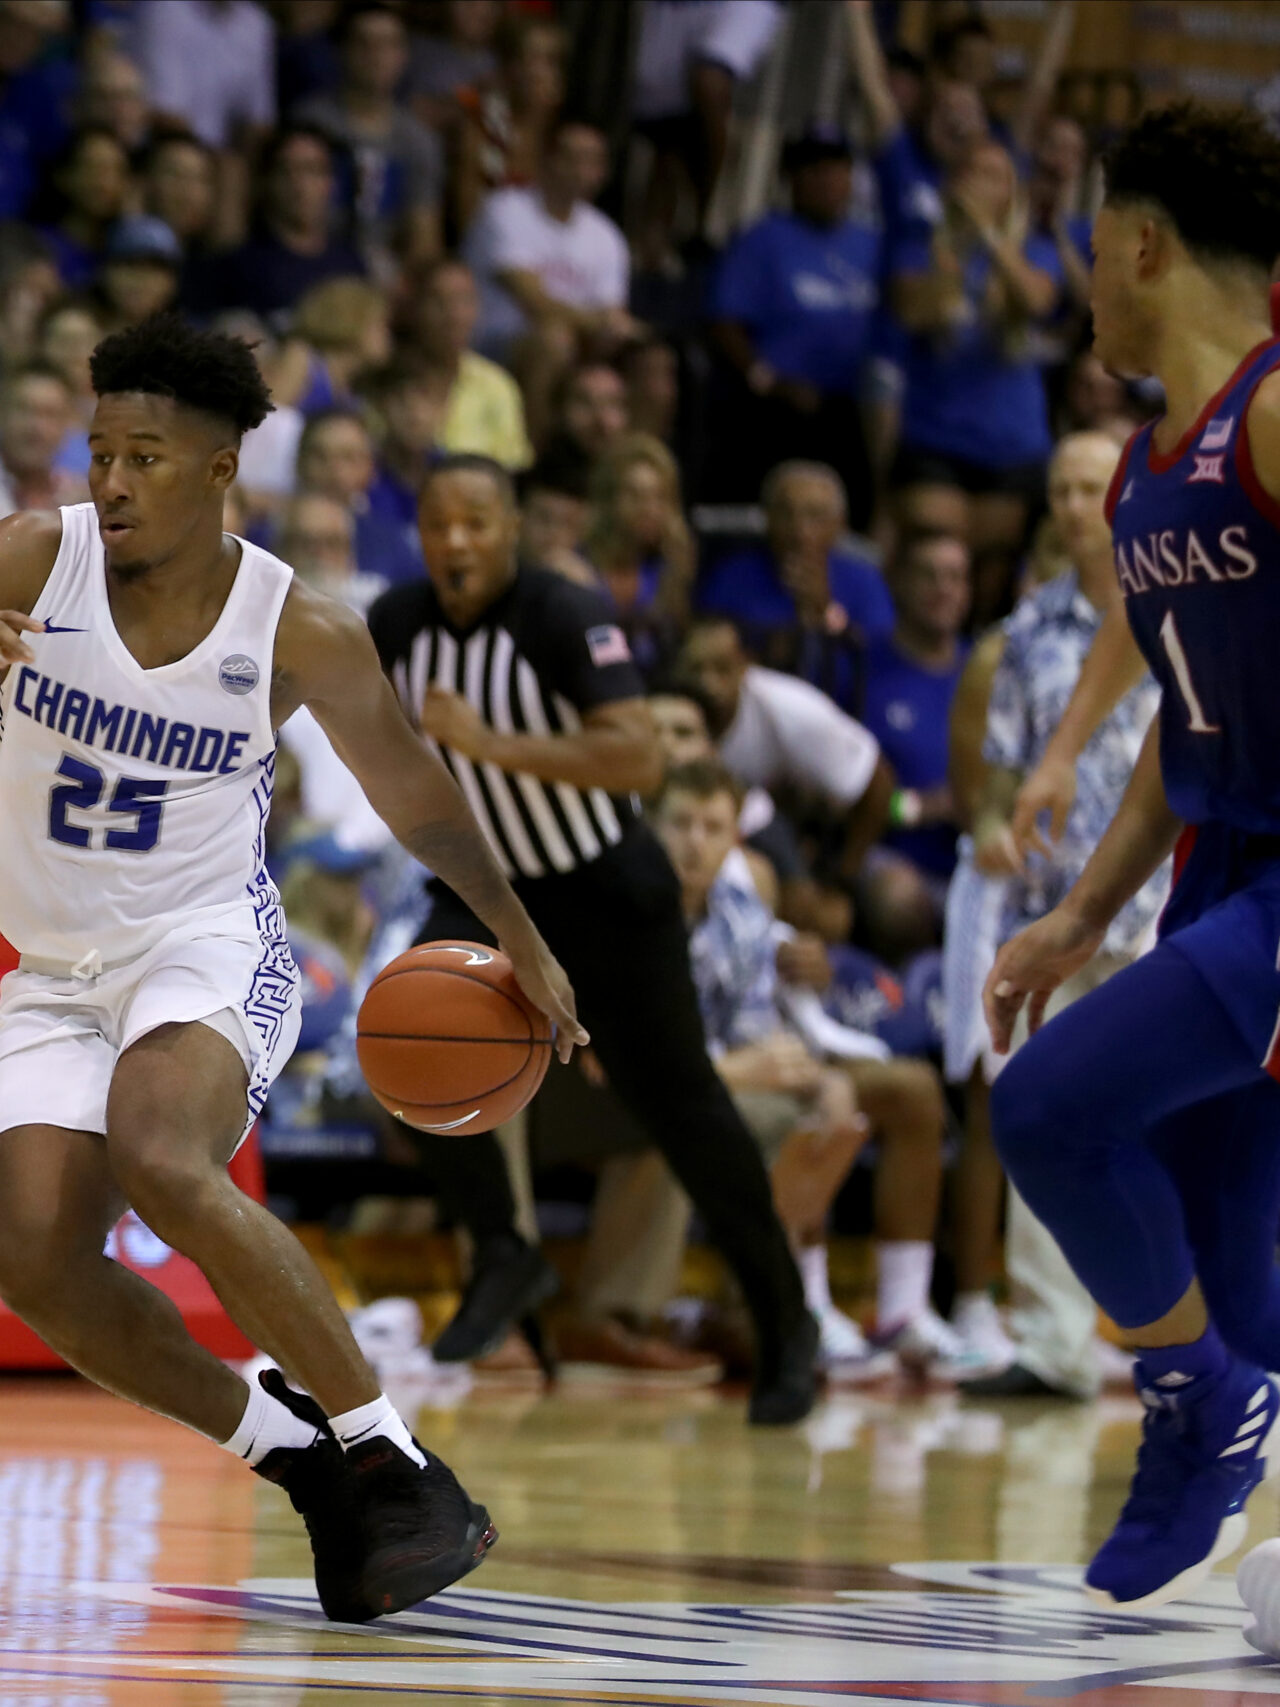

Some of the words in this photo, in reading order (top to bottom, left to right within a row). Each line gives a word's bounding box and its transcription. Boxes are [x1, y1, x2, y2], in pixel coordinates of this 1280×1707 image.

[1187, 453, 1224, 484] XII
[14, 665, 251, 775] CHAMINADE
[1158, 610, 1221, 733] 1
[47, 750, 169, 854] 25
